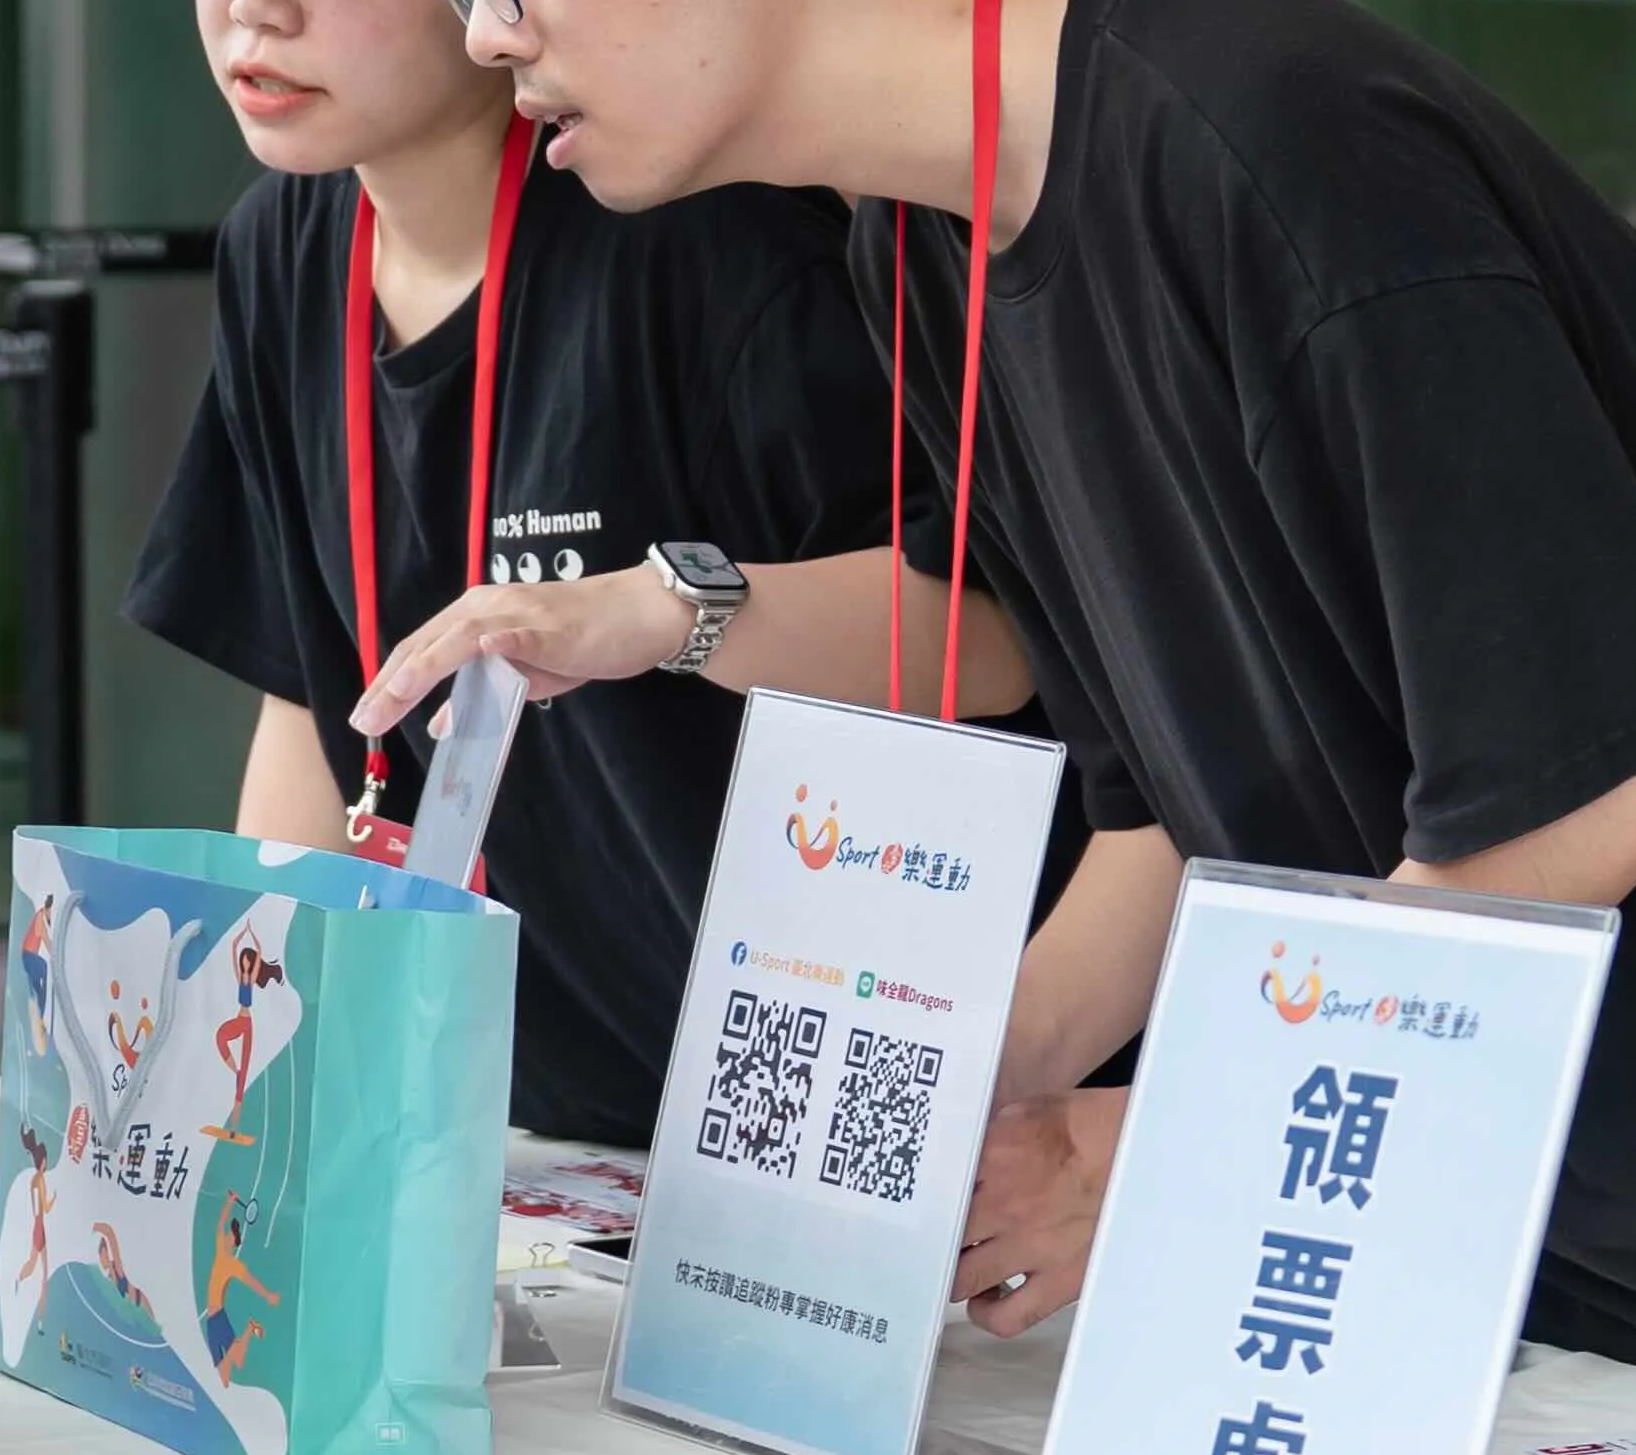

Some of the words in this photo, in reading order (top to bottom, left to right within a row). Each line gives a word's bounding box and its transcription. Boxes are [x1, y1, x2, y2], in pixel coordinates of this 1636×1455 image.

[526, 509, 601, 535] Human
[836, 836, 881, 870] Sport
[1320, 990, 1373, 1022] Sport
